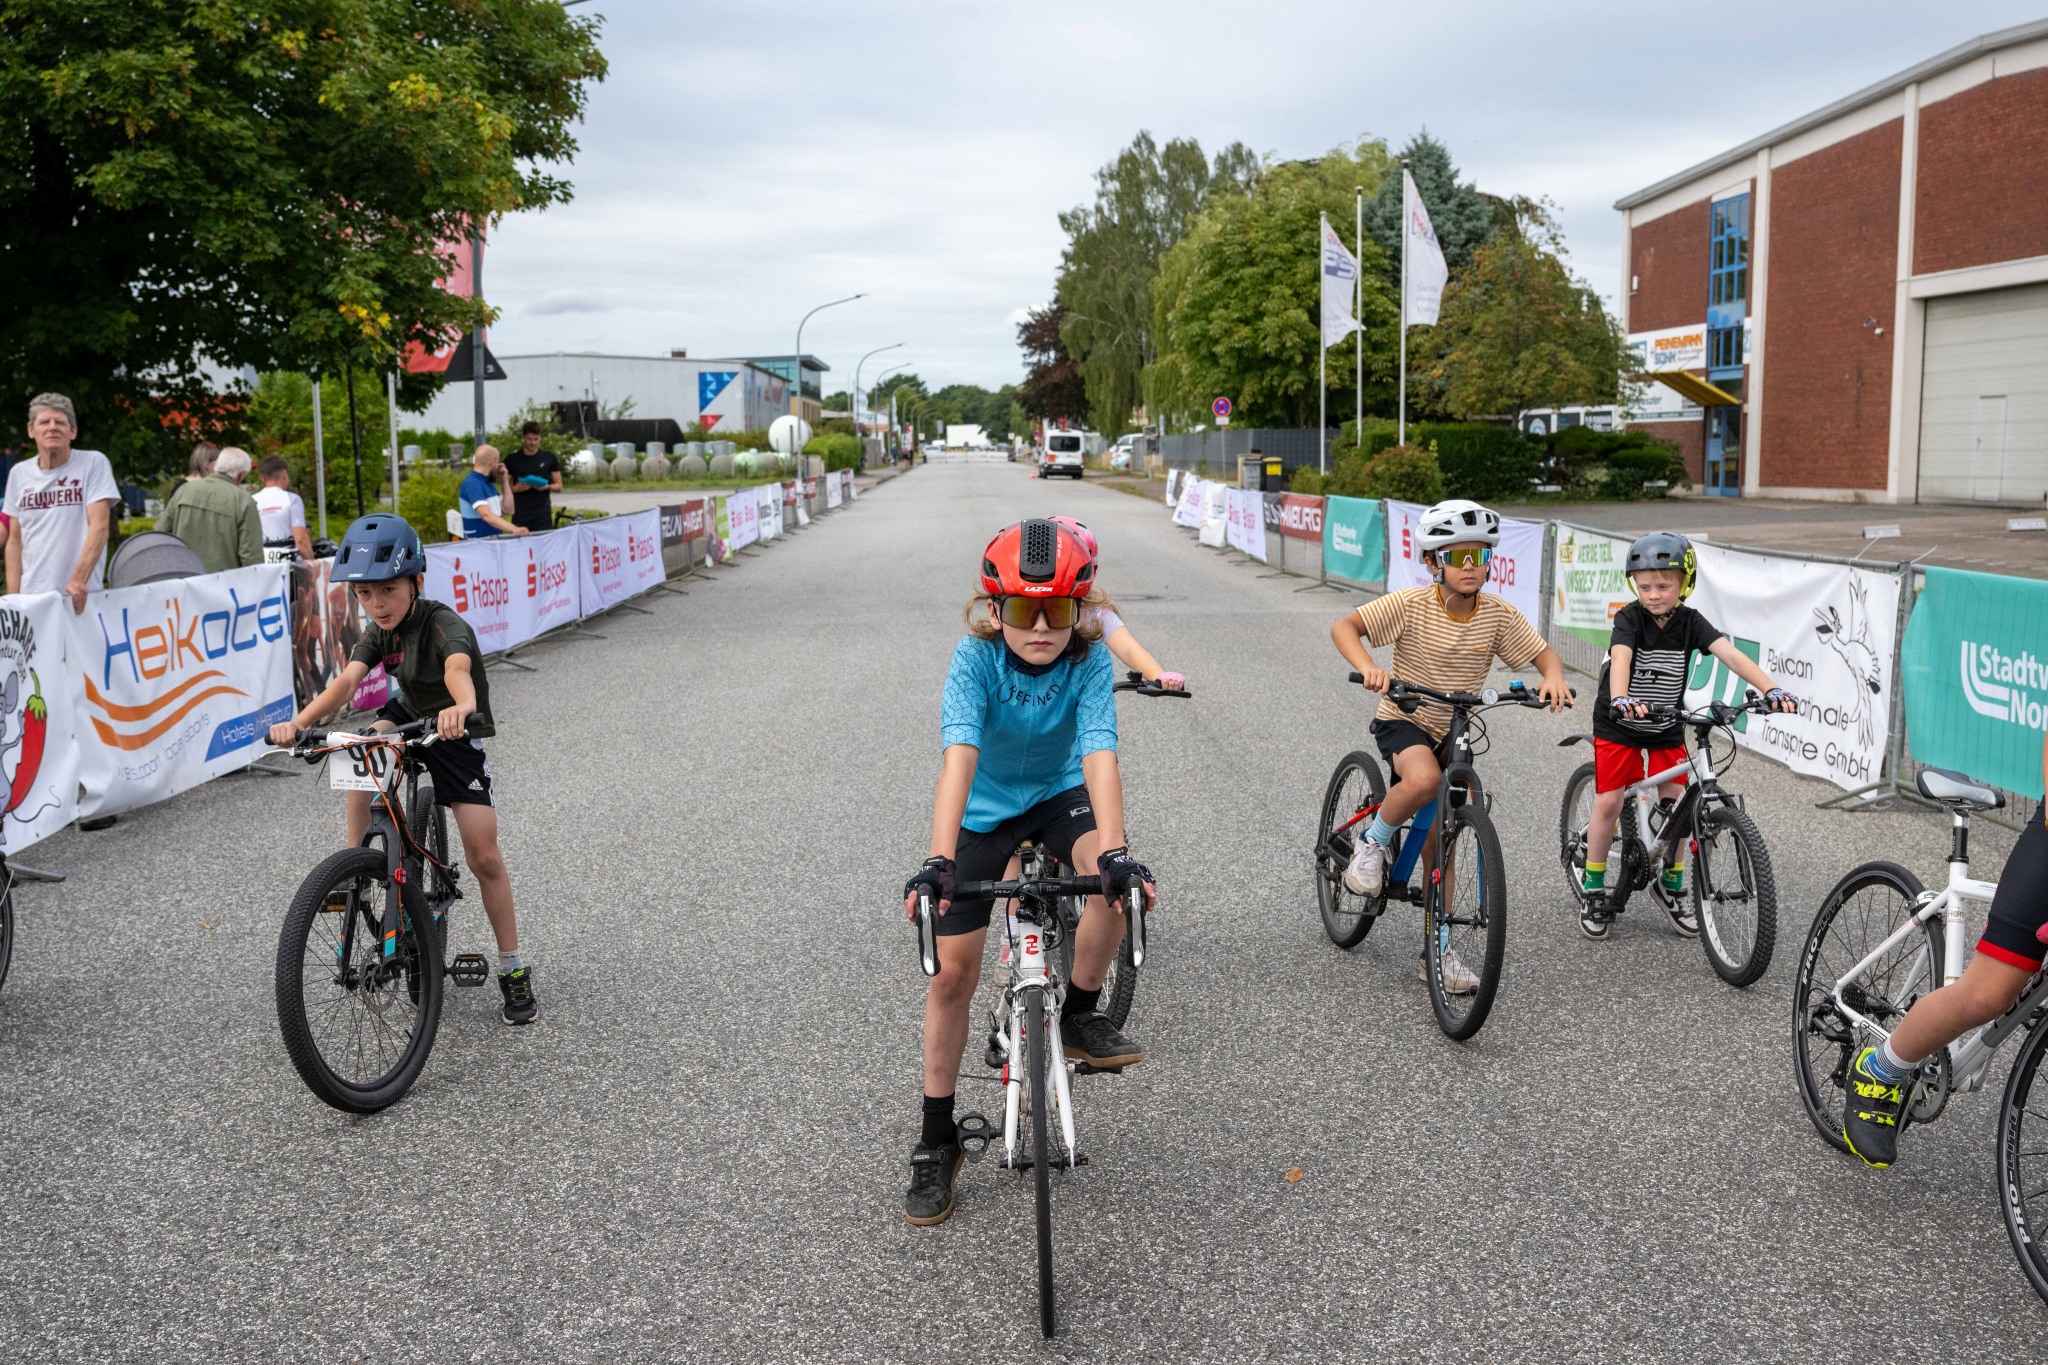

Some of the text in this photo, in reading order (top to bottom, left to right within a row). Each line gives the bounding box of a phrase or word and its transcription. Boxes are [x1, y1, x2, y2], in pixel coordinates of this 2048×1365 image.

[470, 571, 509, 616] Haspa
[0, 608, 36, 665] CHARF
[98, 574, 292, 691] Heikotel
[1767, 648, 1813, 680] Pelican
[163, 734, 185, 762] local
[184, 711, 211, 744] sports
[221, 722, 256, 747] Hotels
[261, 703, 292, 730] Hamburg
[347, 741, 388, 778] 90
[1824, 741, 1871, 783] GmbH
[2006, 1104, 2032, 1245] PRO-LITE
